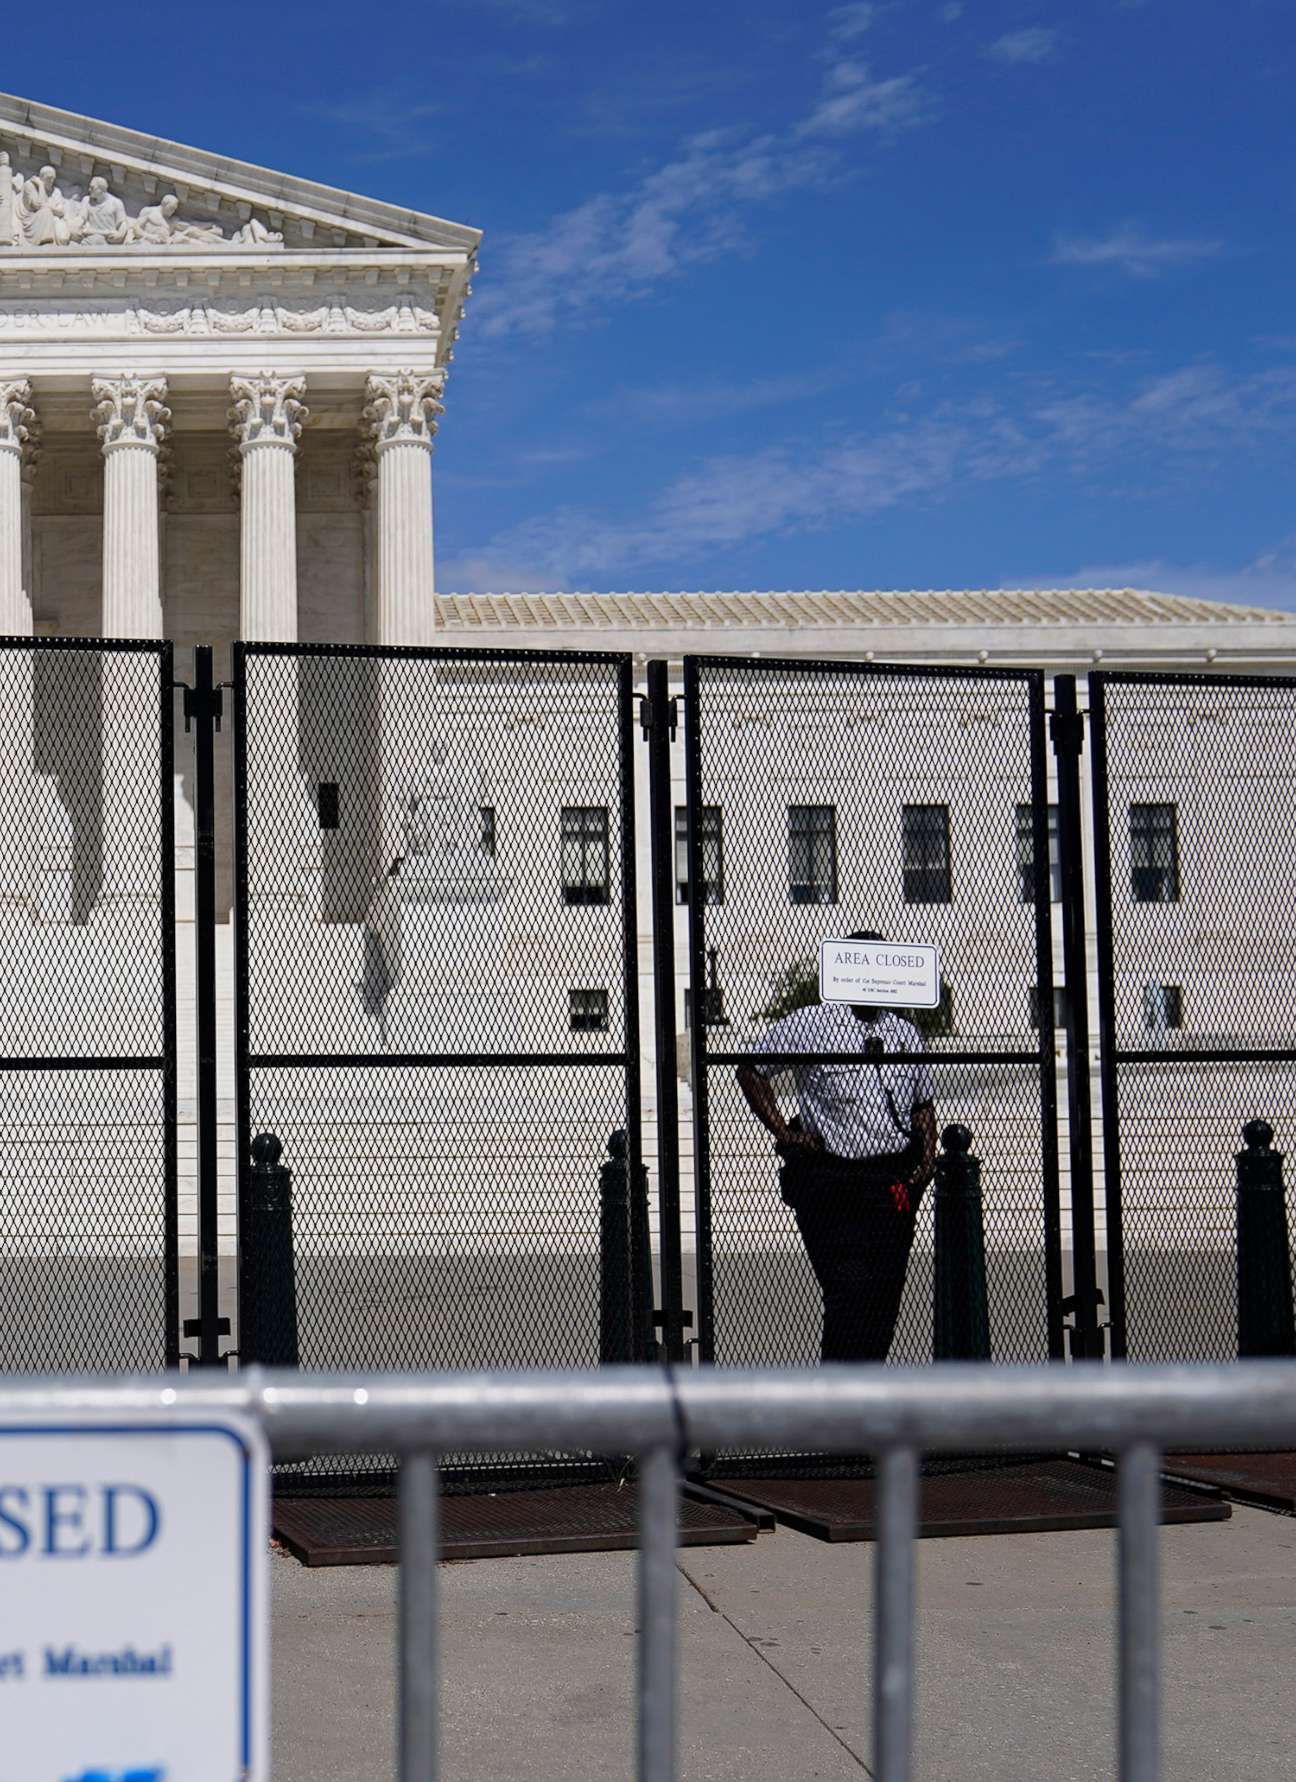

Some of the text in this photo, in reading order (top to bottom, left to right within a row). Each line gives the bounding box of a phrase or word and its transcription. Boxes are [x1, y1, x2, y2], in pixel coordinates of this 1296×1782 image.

[834, 952, 925, 968] AREA CLOSED
[43, 1643, 174, 1679] Marshal
